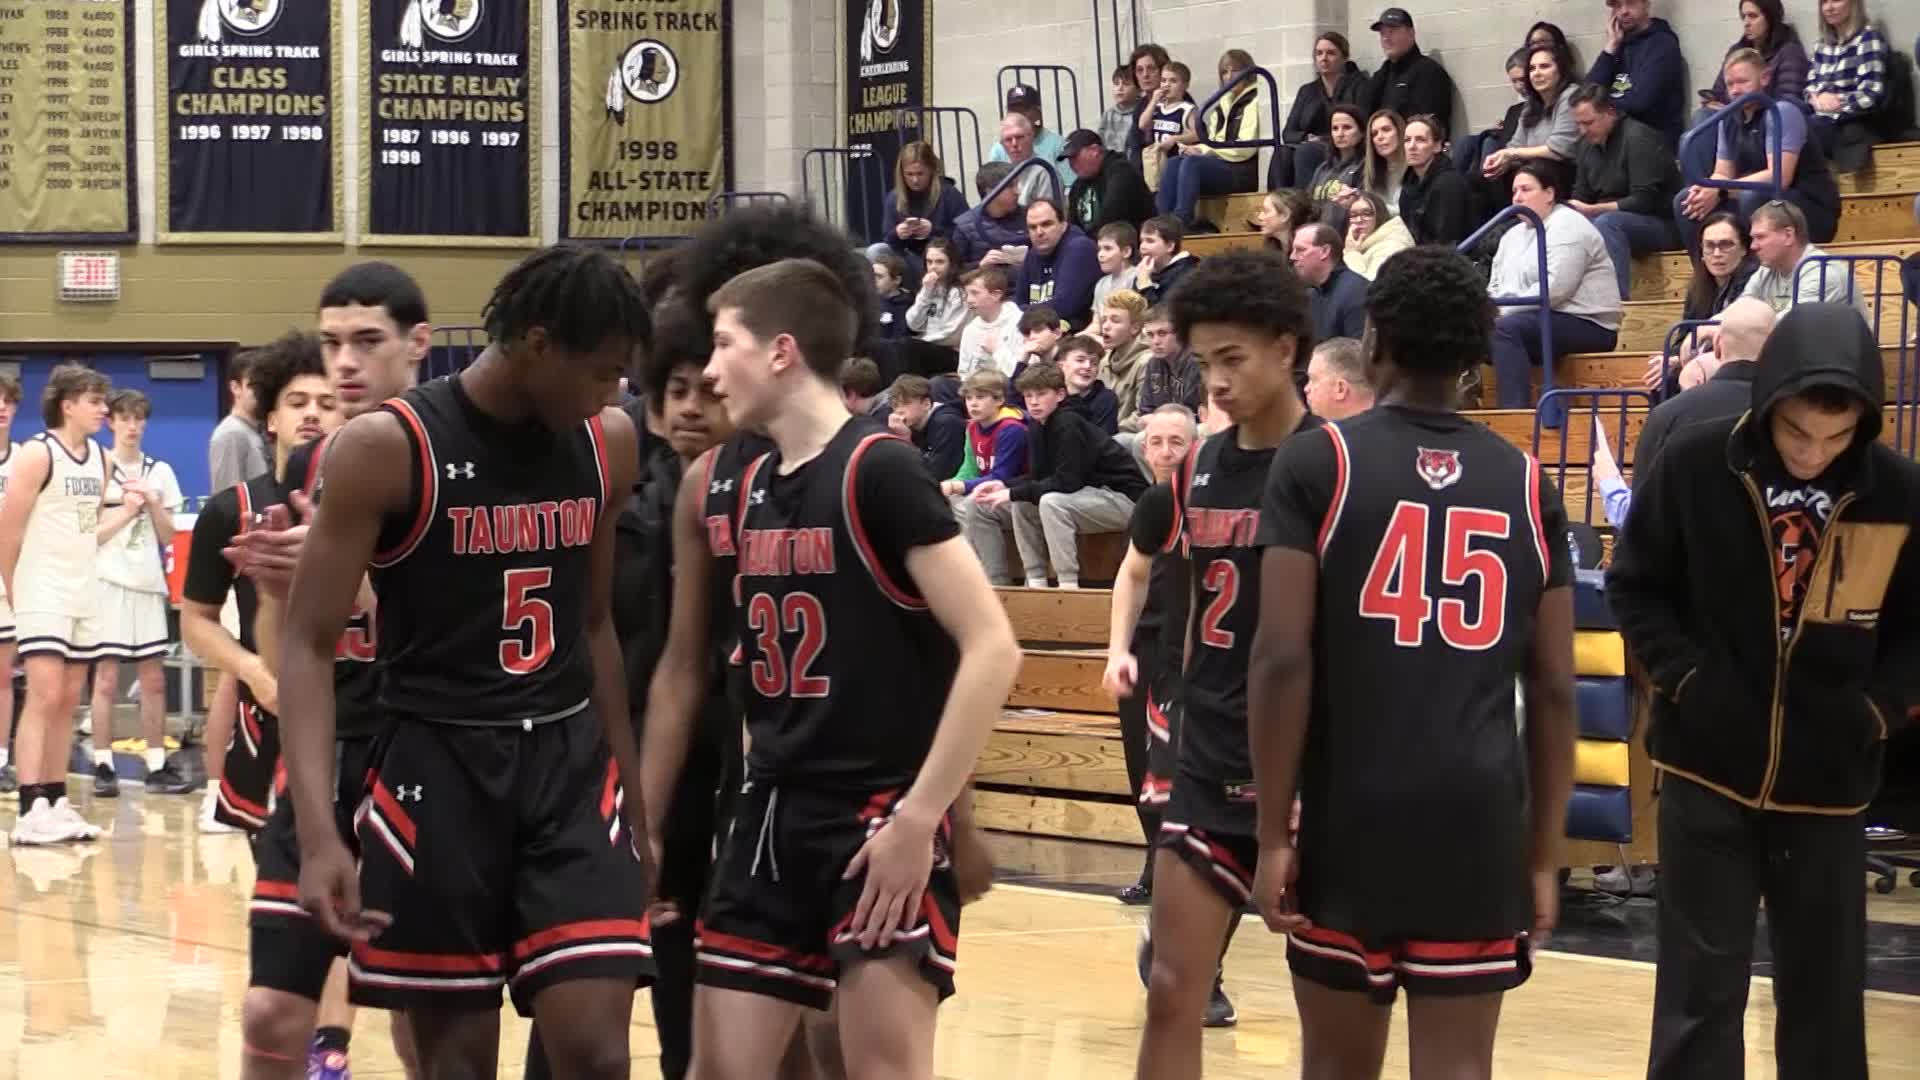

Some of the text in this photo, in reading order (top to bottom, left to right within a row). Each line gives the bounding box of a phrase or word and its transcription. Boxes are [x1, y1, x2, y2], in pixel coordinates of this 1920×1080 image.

[575, 10, 719, 31] SPRING TRACK
[179, 45, 320, 58] GIRLS SPRING TRACK
[381, 49, 519, 66] GIRLS SPRING TRACK
[213, 67, 288, 89] CLASS
[379, 73, 520, 97] STATE RELAY
[176, 93, 326, 116] CHAMPIONS
[863, 83, 908, 108] LEAGUE
[378, 98, 525, 122] CHAMPIONS
[180, 125, 323, 141] 1996 1997 1998
[383, 129, 520, 146] 1987 1996 1997
[382, 150, 421, 165] 1998
[618, 141, 678, 160] 1998
[588, 171, 711, 191] ALL-STATE
[448, 497, 596, 555] TAUNTON
[1359, 499, 1511, 651] 45
[1202, 558, 1240, 649] 2
[499, 566, 555, 674] 5
[748, 591, 831, 698] 32
